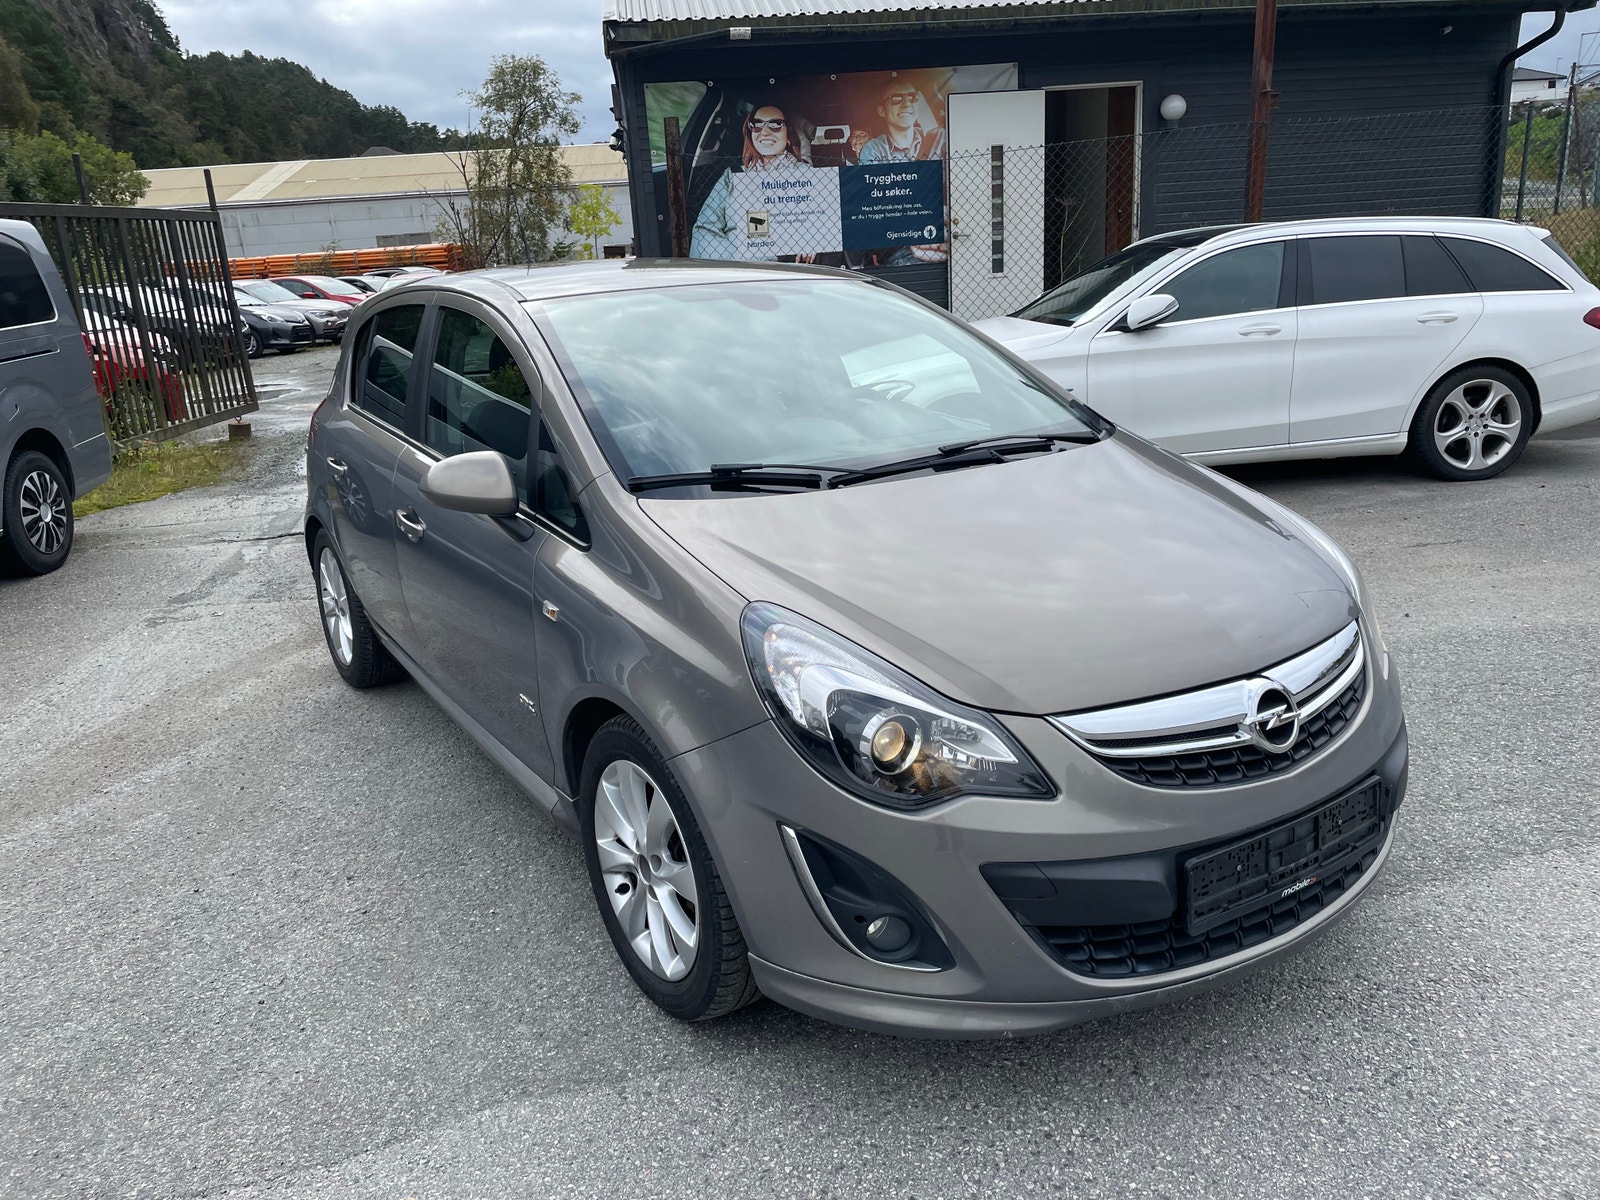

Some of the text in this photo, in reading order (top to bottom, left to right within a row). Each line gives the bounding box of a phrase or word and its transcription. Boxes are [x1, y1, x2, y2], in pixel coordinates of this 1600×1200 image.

[865, 173, 917, 185] Tryggheten
[761, 180, 812, 190] Muligheten
[871, 187, 913, 197] du søker.
[764, 194, 812, 204] du trenger.
[887, 231, 922, 240] Gjensidige
